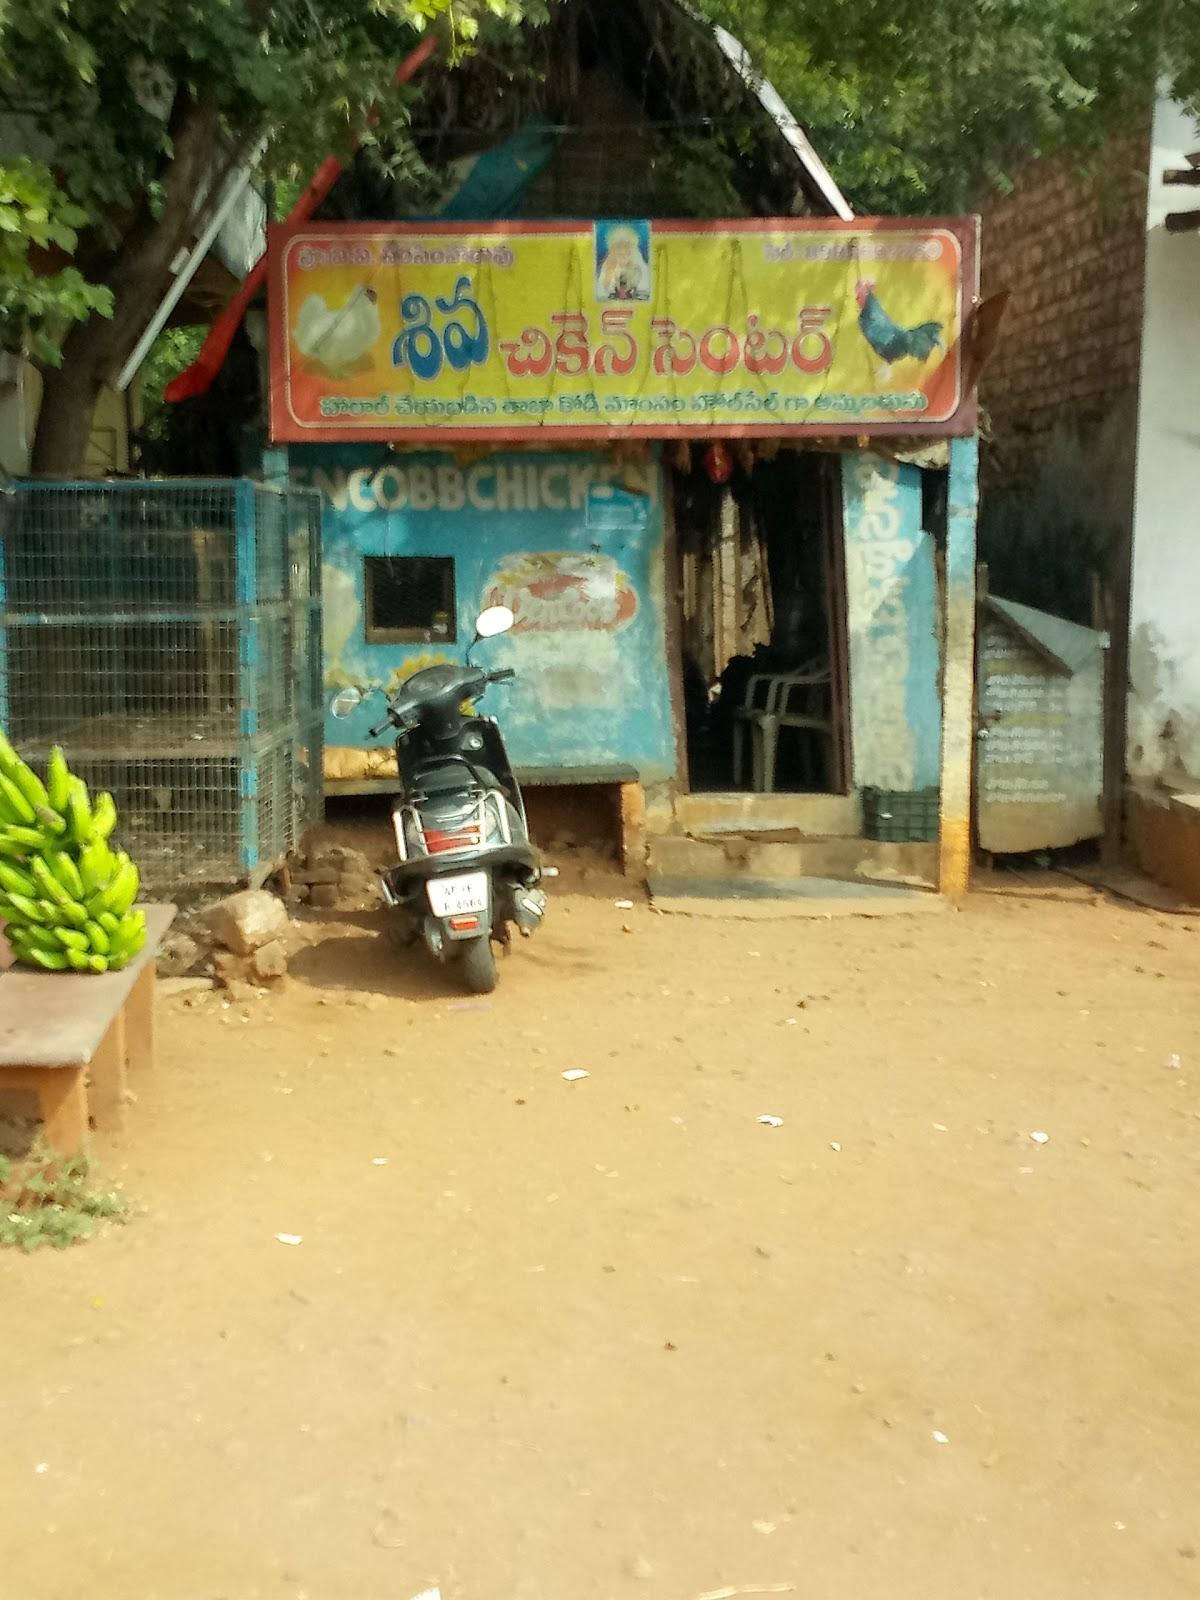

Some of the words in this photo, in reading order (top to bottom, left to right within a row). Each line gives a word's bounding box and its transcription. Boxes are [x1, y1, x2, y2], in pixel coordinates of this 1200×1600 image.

[392, 275, 490, 381] శివ
[500, 308, 639, 377] చికెన్
[651, 304, 833, 375] సెంటర్
